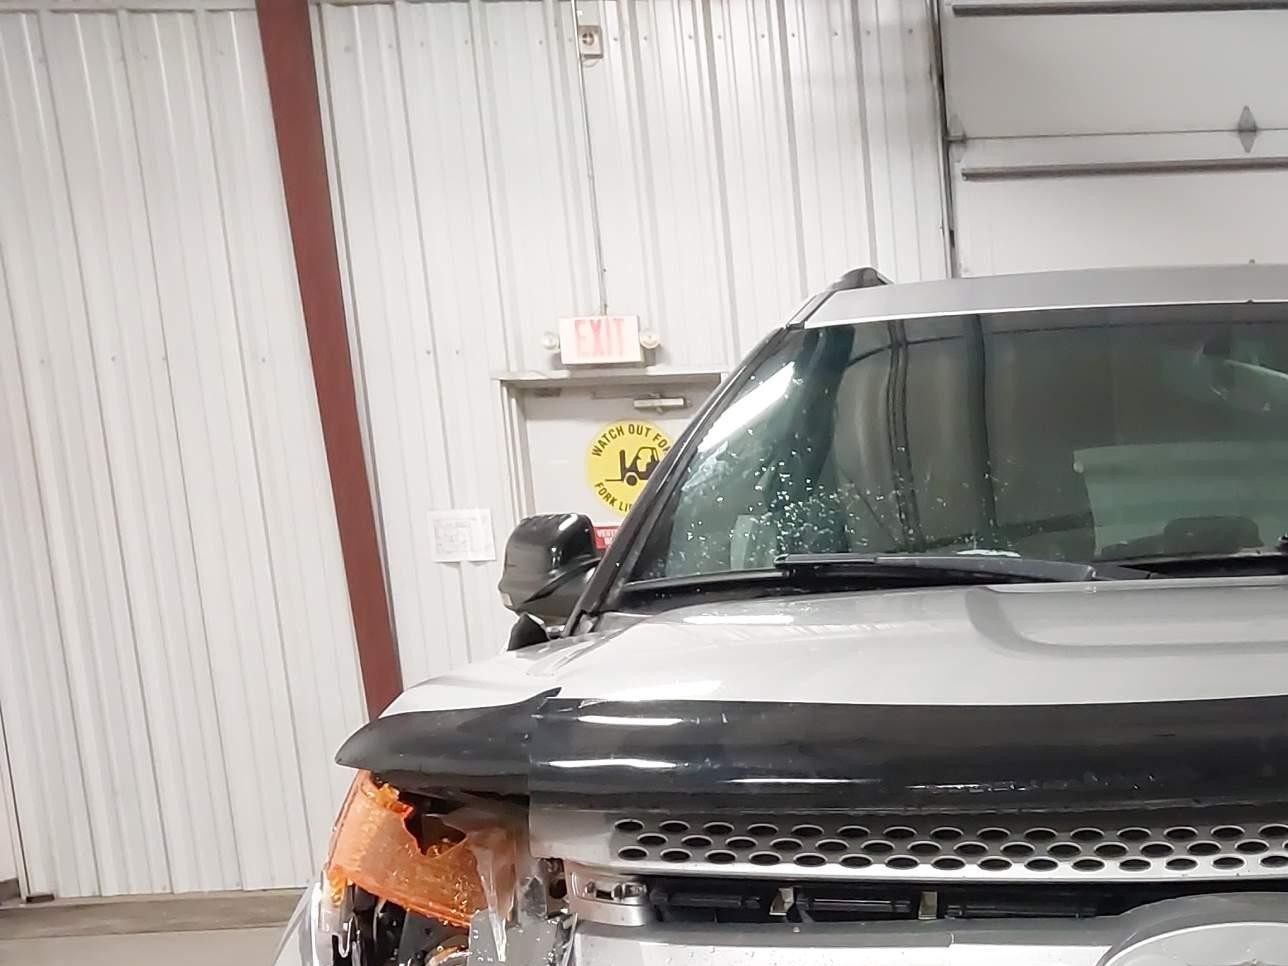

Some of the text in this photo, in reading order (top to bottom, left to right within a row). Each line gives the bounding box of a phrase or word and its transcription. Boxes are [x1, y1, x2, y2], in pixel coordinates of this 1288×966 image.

[574, 318, 624, 357] EXIT
[592, 426, 624, 457] WATCH
[628, 424, 652, 437] OUT
[594, 482, 618, 507] FORK
